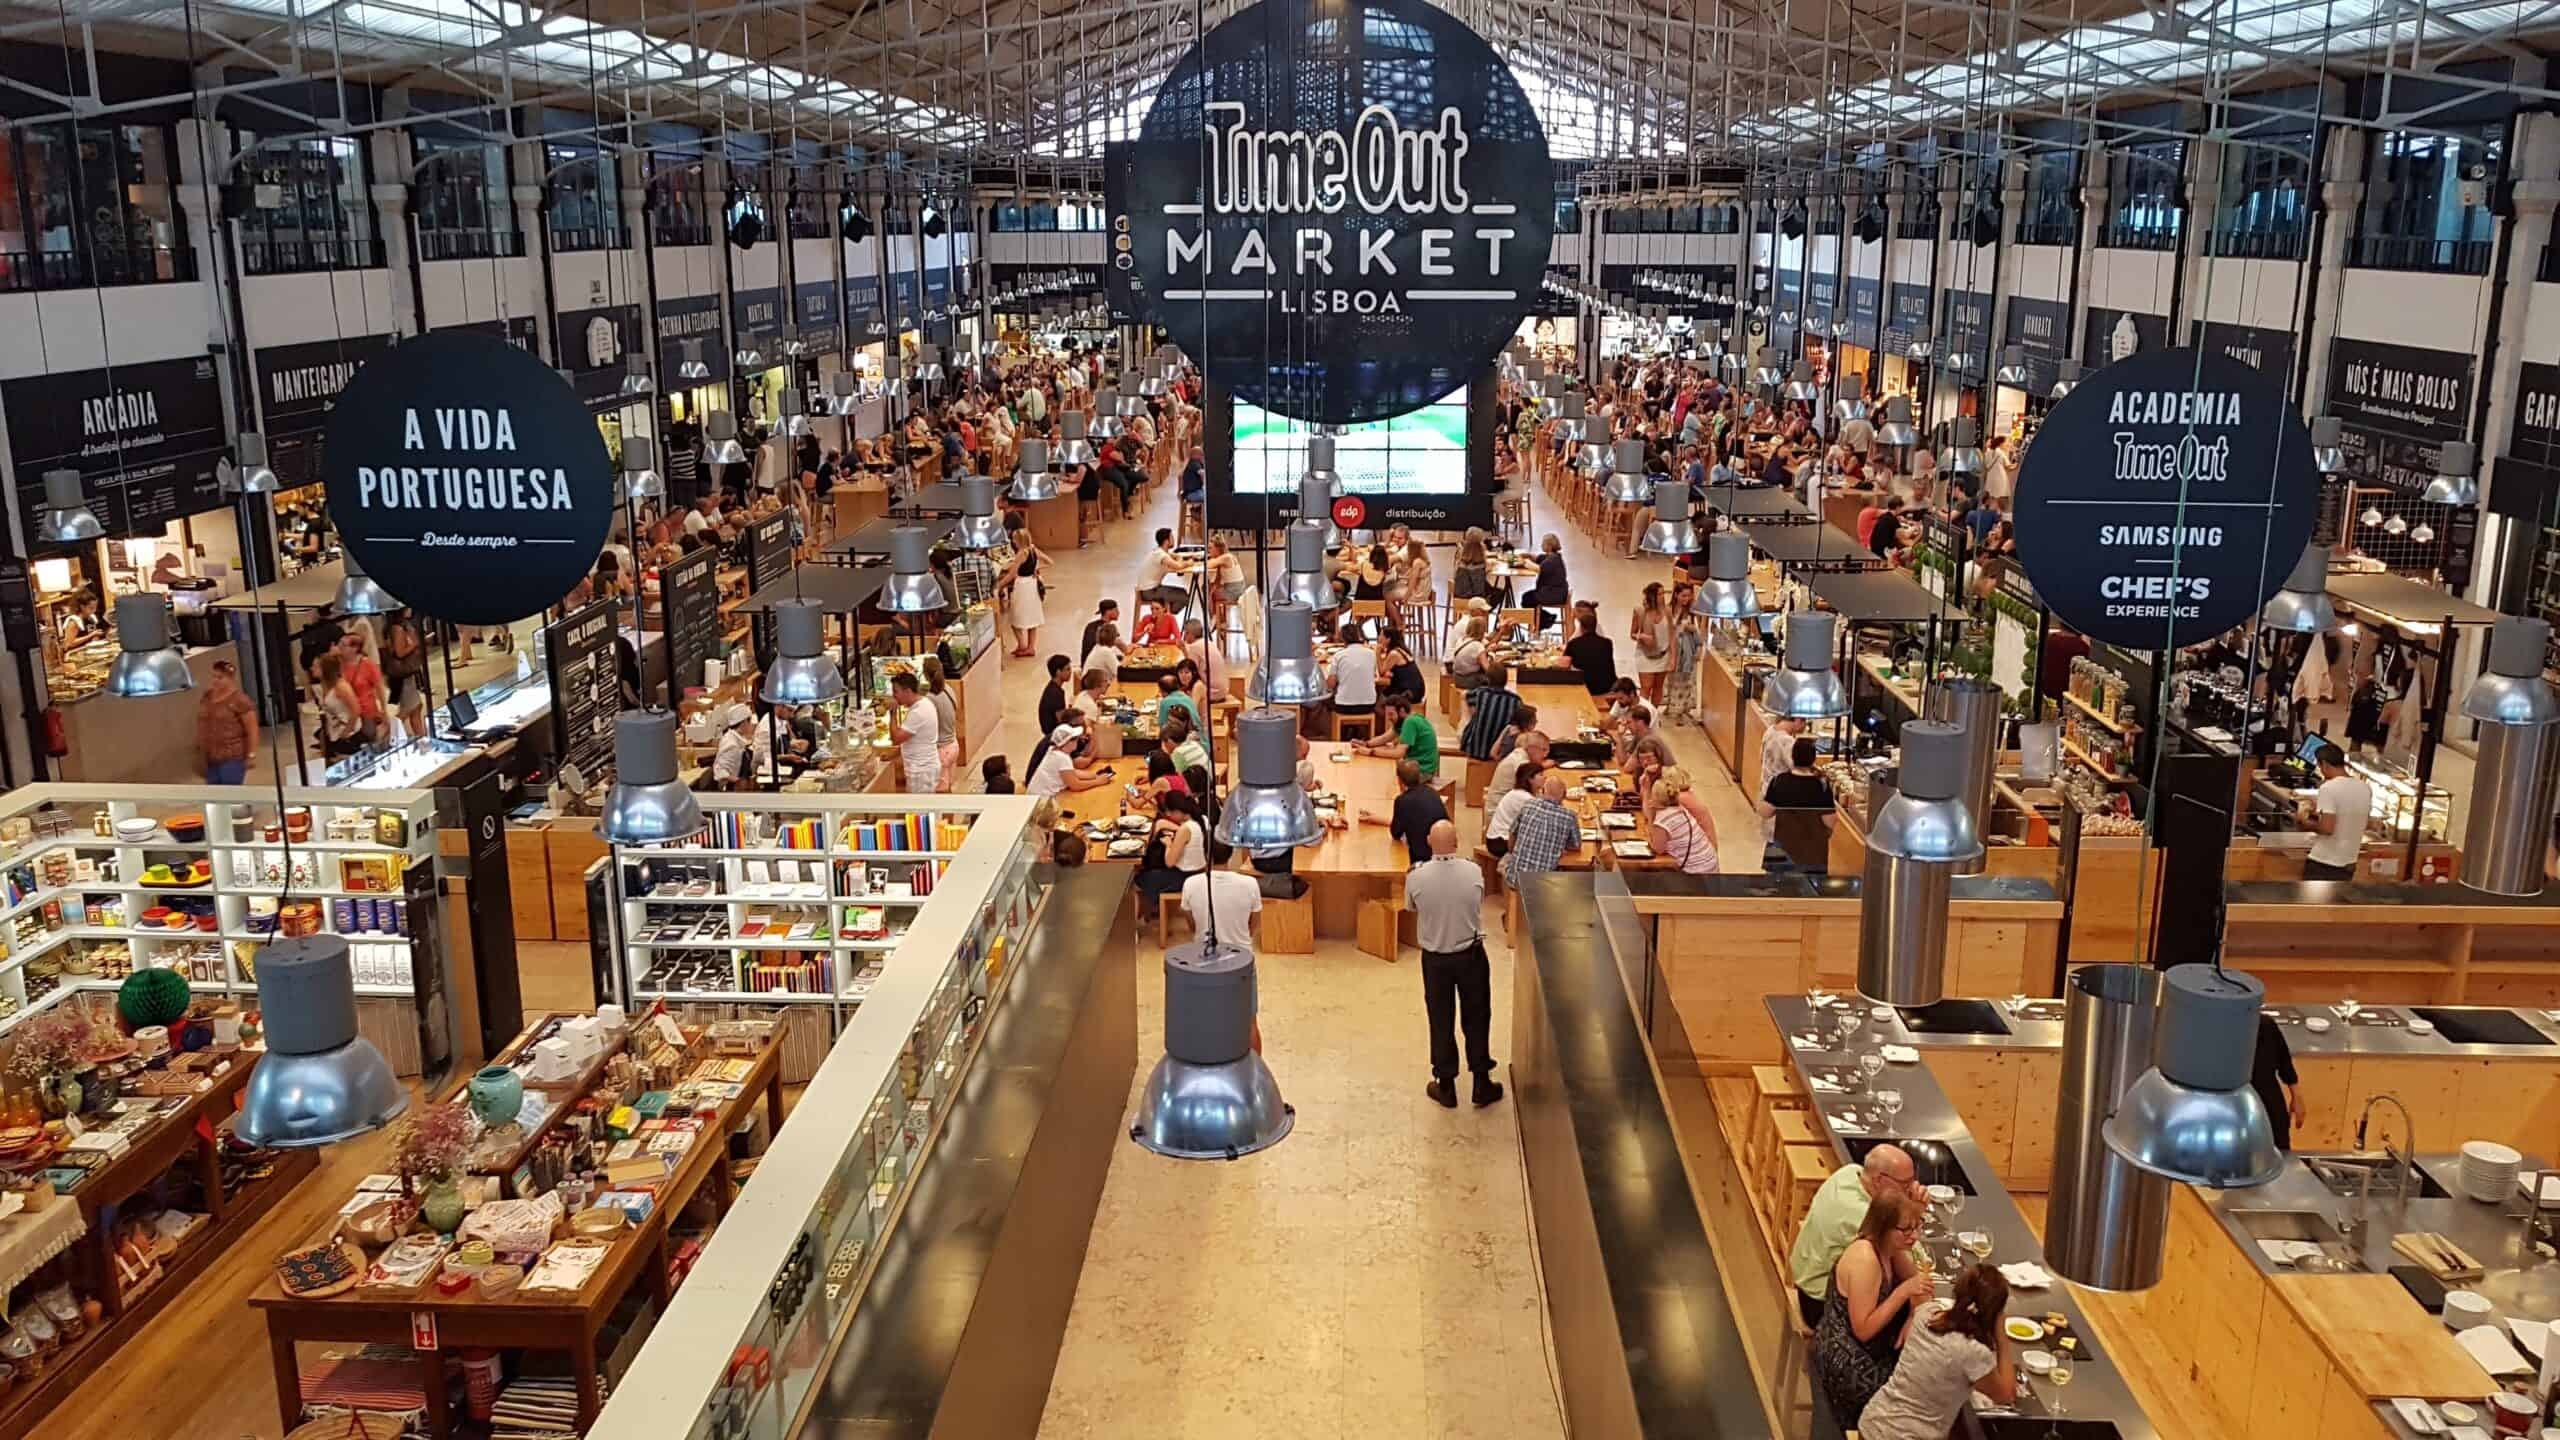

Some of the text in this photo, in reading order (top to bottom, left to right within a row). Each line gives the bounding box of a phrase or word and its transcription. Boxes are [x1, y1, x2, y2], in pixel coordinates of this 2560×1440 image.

[1204, 102, 1469, 214] Time Out
[1166, 229, 1515, 276] MARKET
[1280, 289, 1401, 313] LISBOA
[2345, 359, 2459, 411] NÓS É MAIS BOLOS
[82, 387, 158, 436] ARCÁDIA
[2109, 391, 2241, 425] ACADEMIA
[404, 408, 516, 450] A VIDA
[2113, 432, 2228, 481] Time Out
[358, 467, 573, 510] PORTUGUESA
[1340, 505, 1446, 520] edp distribuição
[421, 531, 518, 549] Desde sempre
[2100, 525, 2224, 547] SAMSUNG
[2100, 576, 2211, 601] CHEF'S
[2106, 604, 2201, 619] EXPERIENCE
